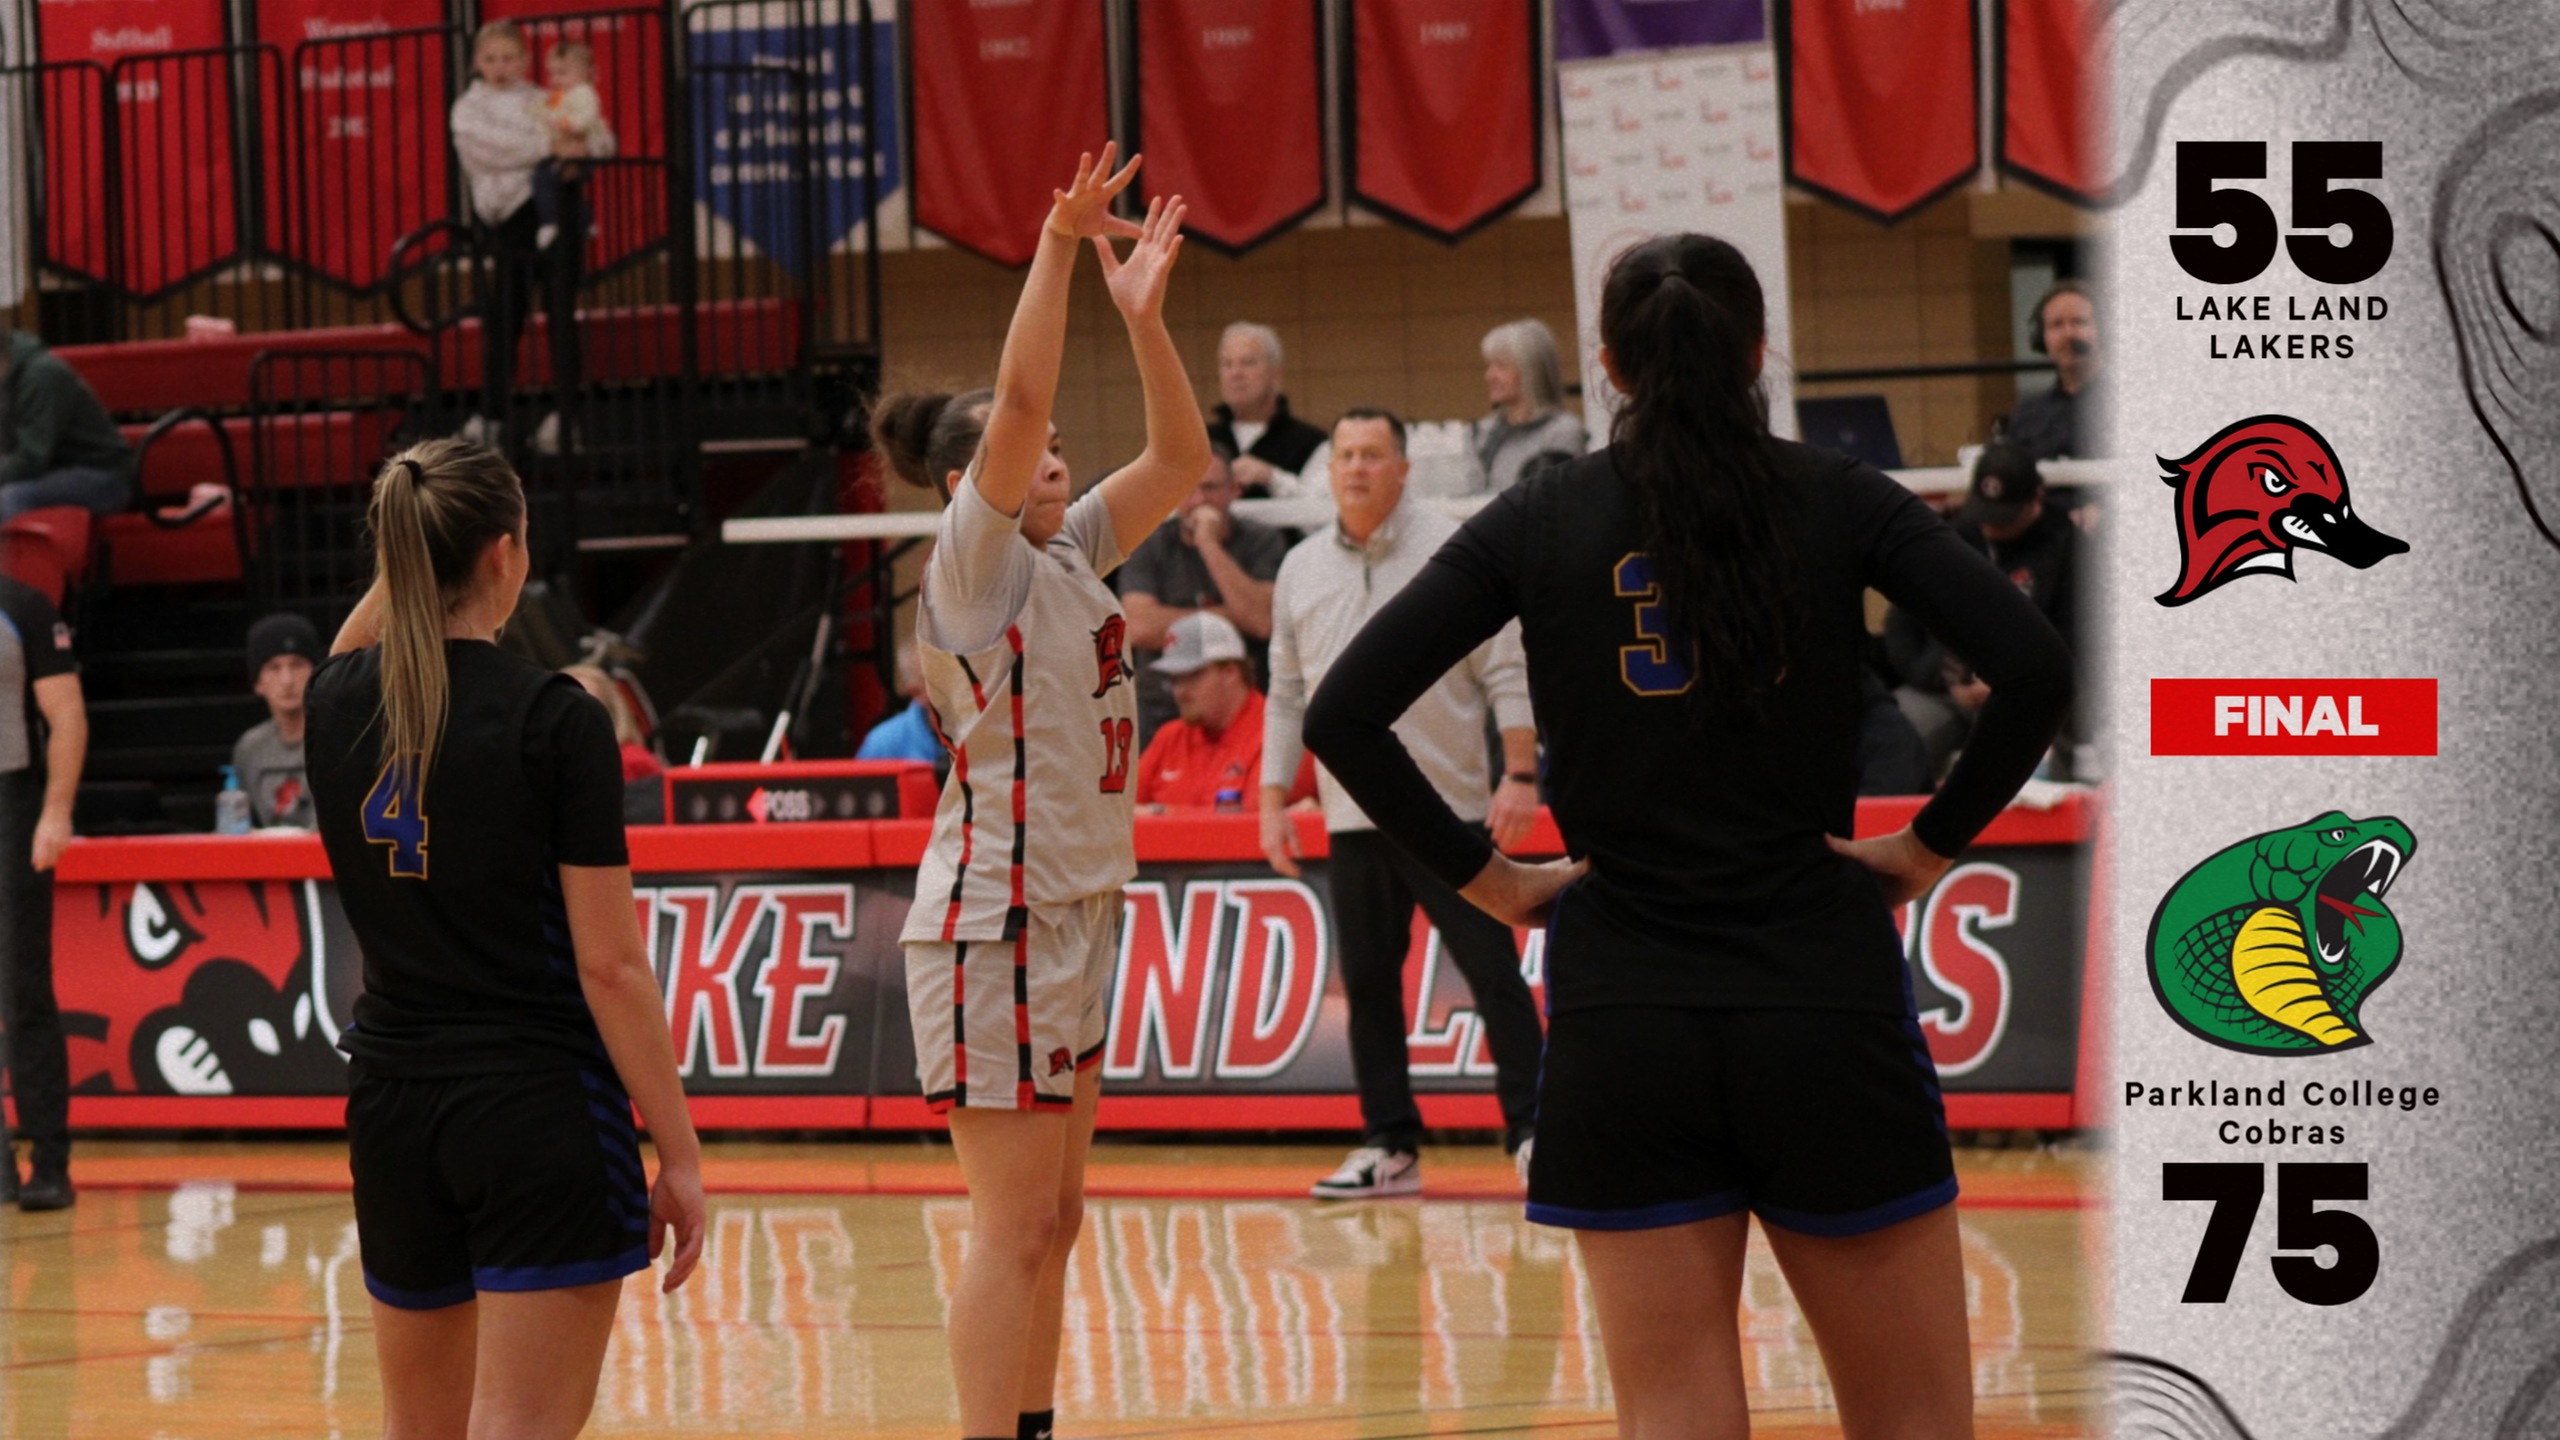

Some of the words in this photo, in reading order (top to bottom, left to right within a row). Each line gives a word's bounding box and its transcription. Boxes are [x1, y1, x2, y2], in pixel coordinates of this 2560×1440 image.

[360, 750, 428, 880] 4
[1100, 716, 1134, 793] 13
[632, 883, 855, 1077] KE
[1102, 878, 1328, 1078] ND
